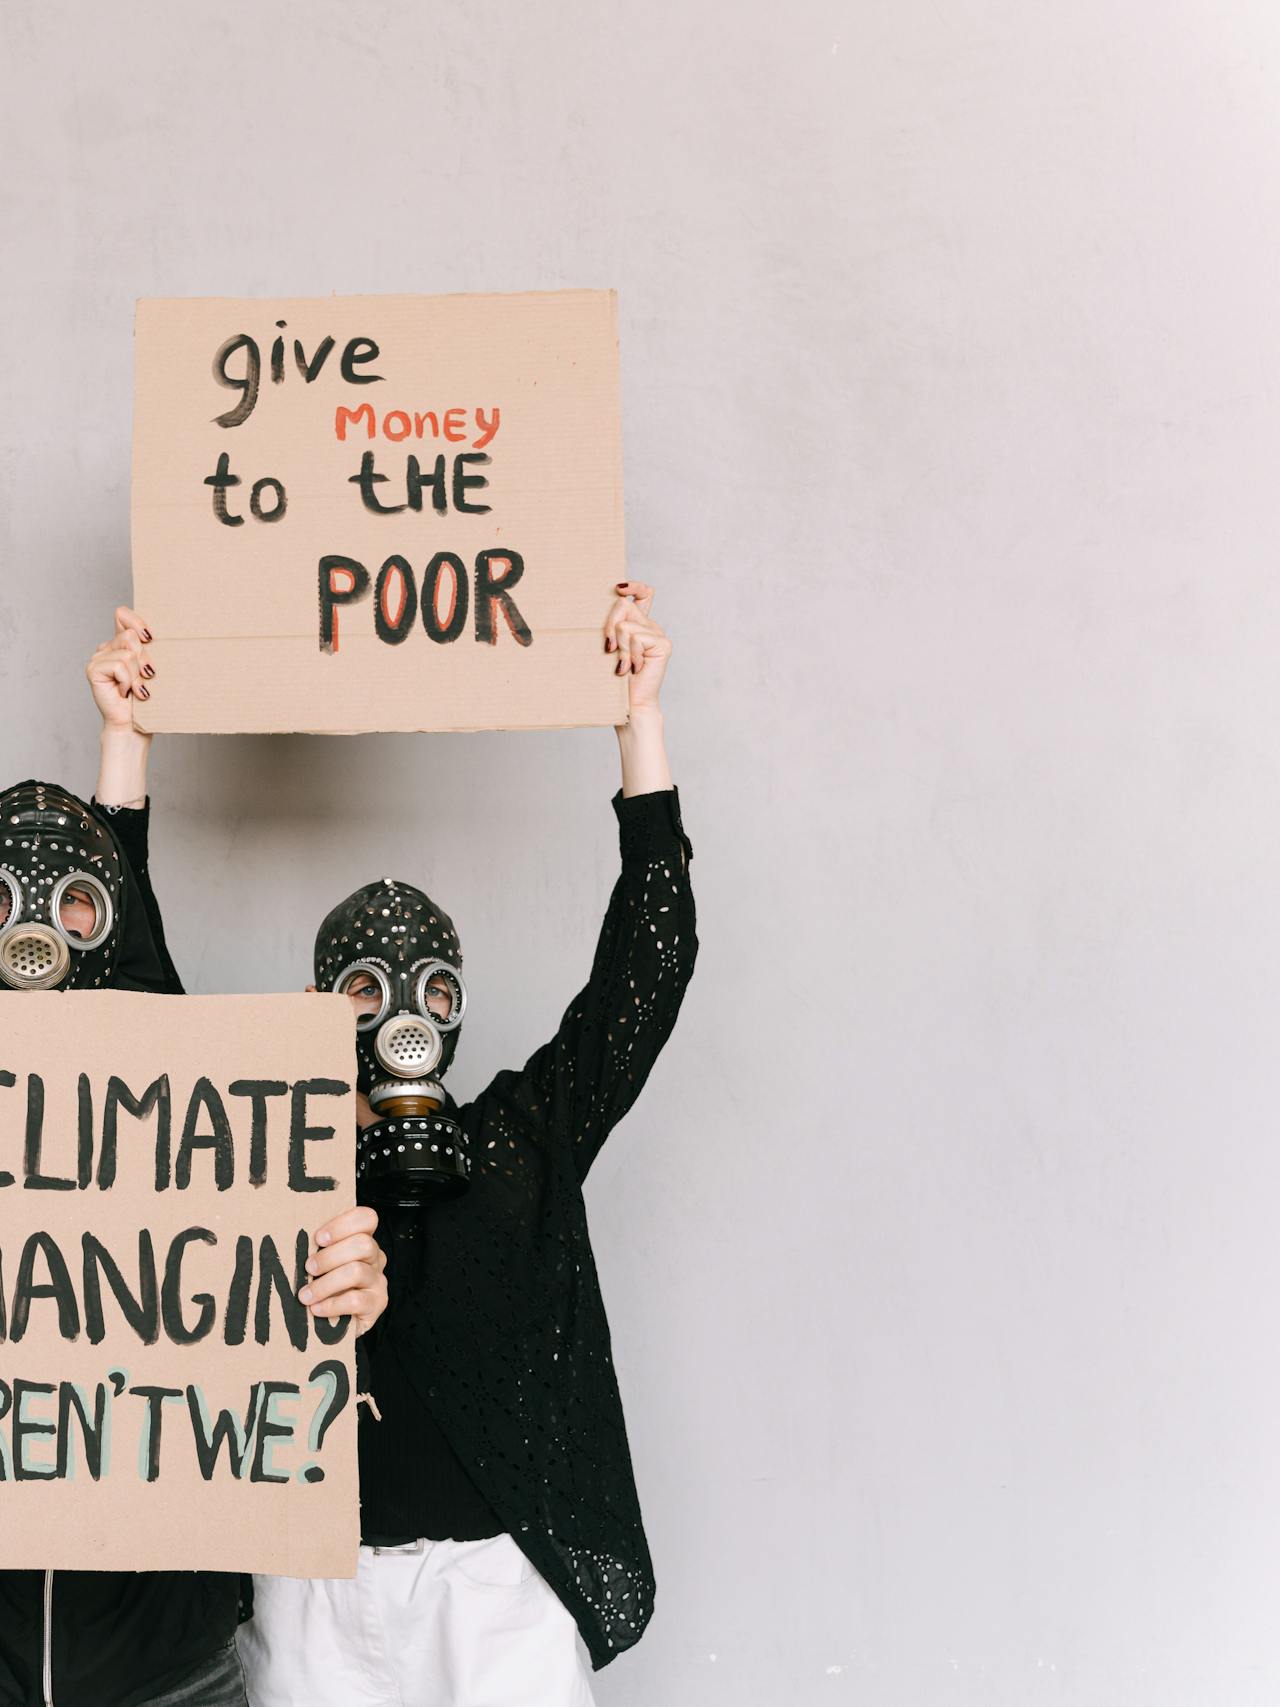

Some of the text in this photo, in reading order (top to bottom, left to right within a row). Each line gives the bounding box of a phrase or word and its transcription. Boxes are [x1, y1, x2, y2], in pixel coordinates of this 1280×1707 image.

[210, 319, 387, 429] give
[203, 451, 288, 527] to
[318, 547, 534, 656] POOR
